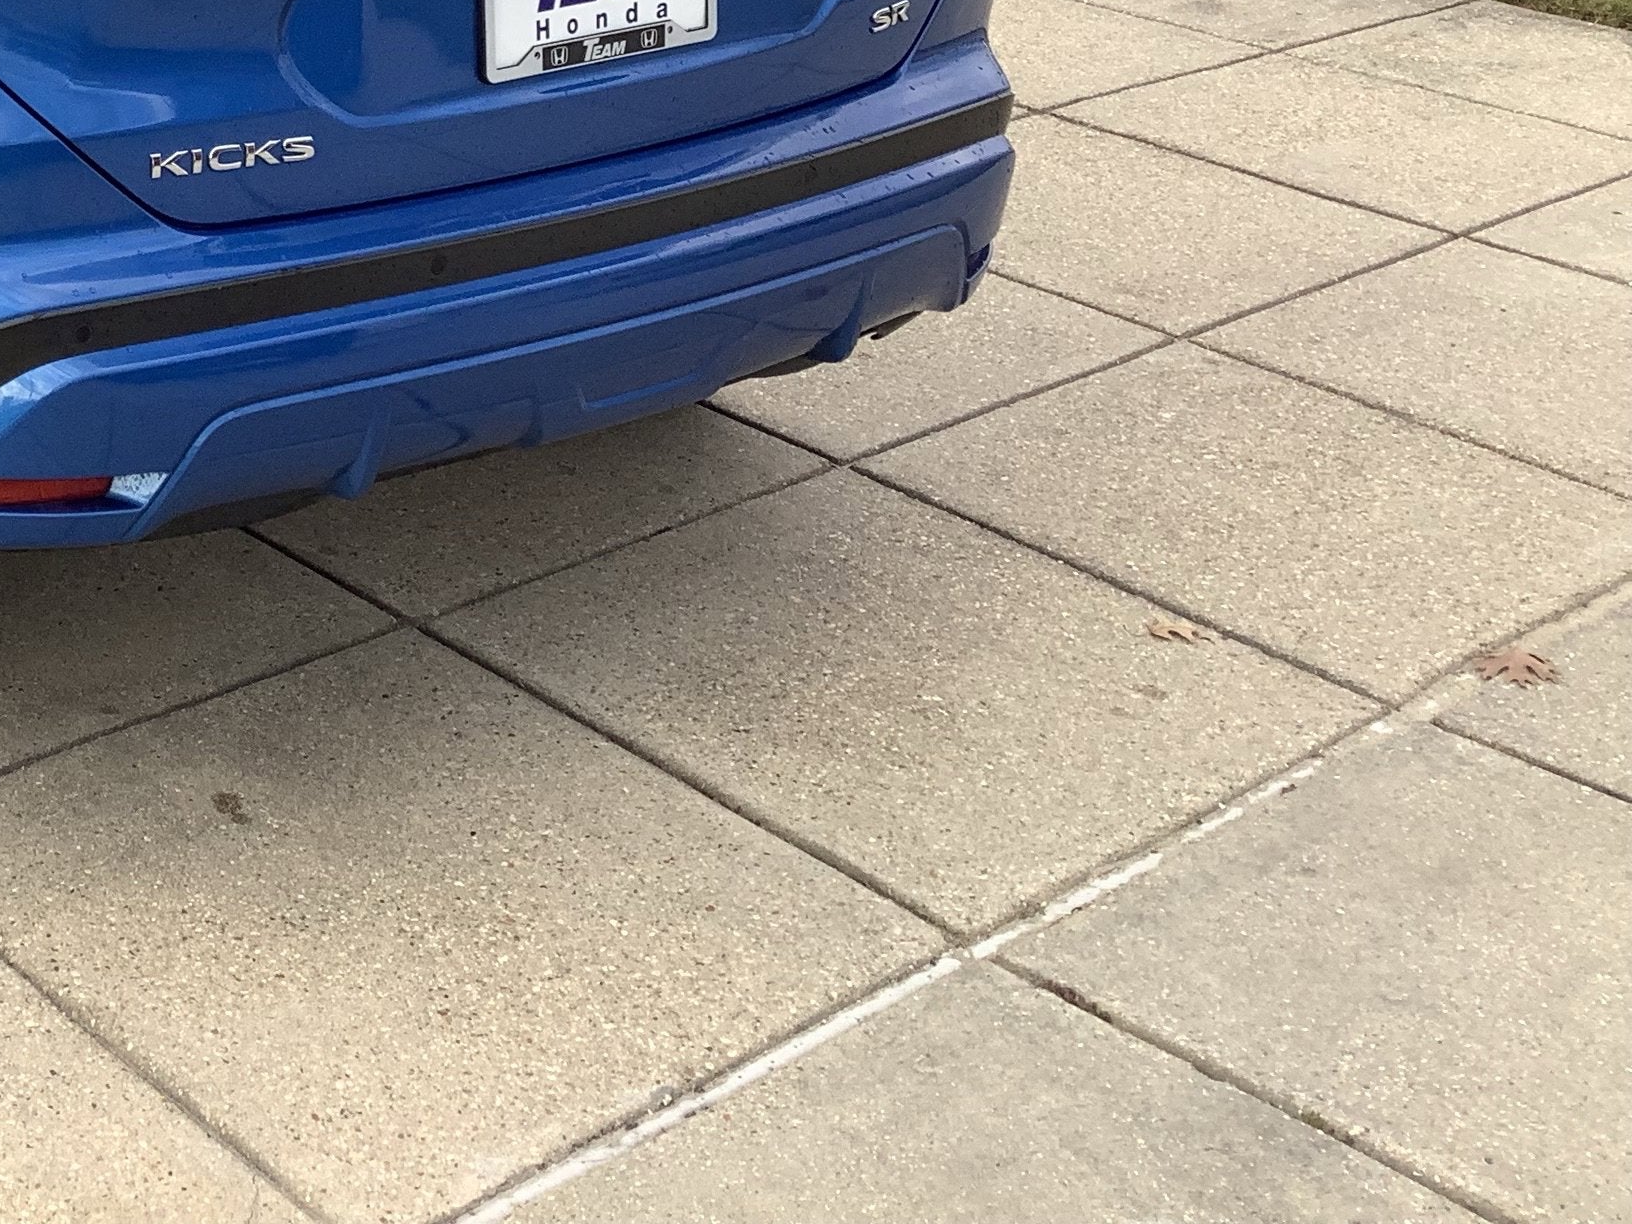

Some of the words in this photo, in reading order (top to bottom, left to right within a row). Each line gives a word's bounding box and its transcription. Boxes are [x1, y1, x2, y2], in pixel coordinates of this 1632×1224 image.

[535, 2, 669, 41] Honda
[871, 0, 911, 33] SR
[149, 135, 316, 179] KICKS
